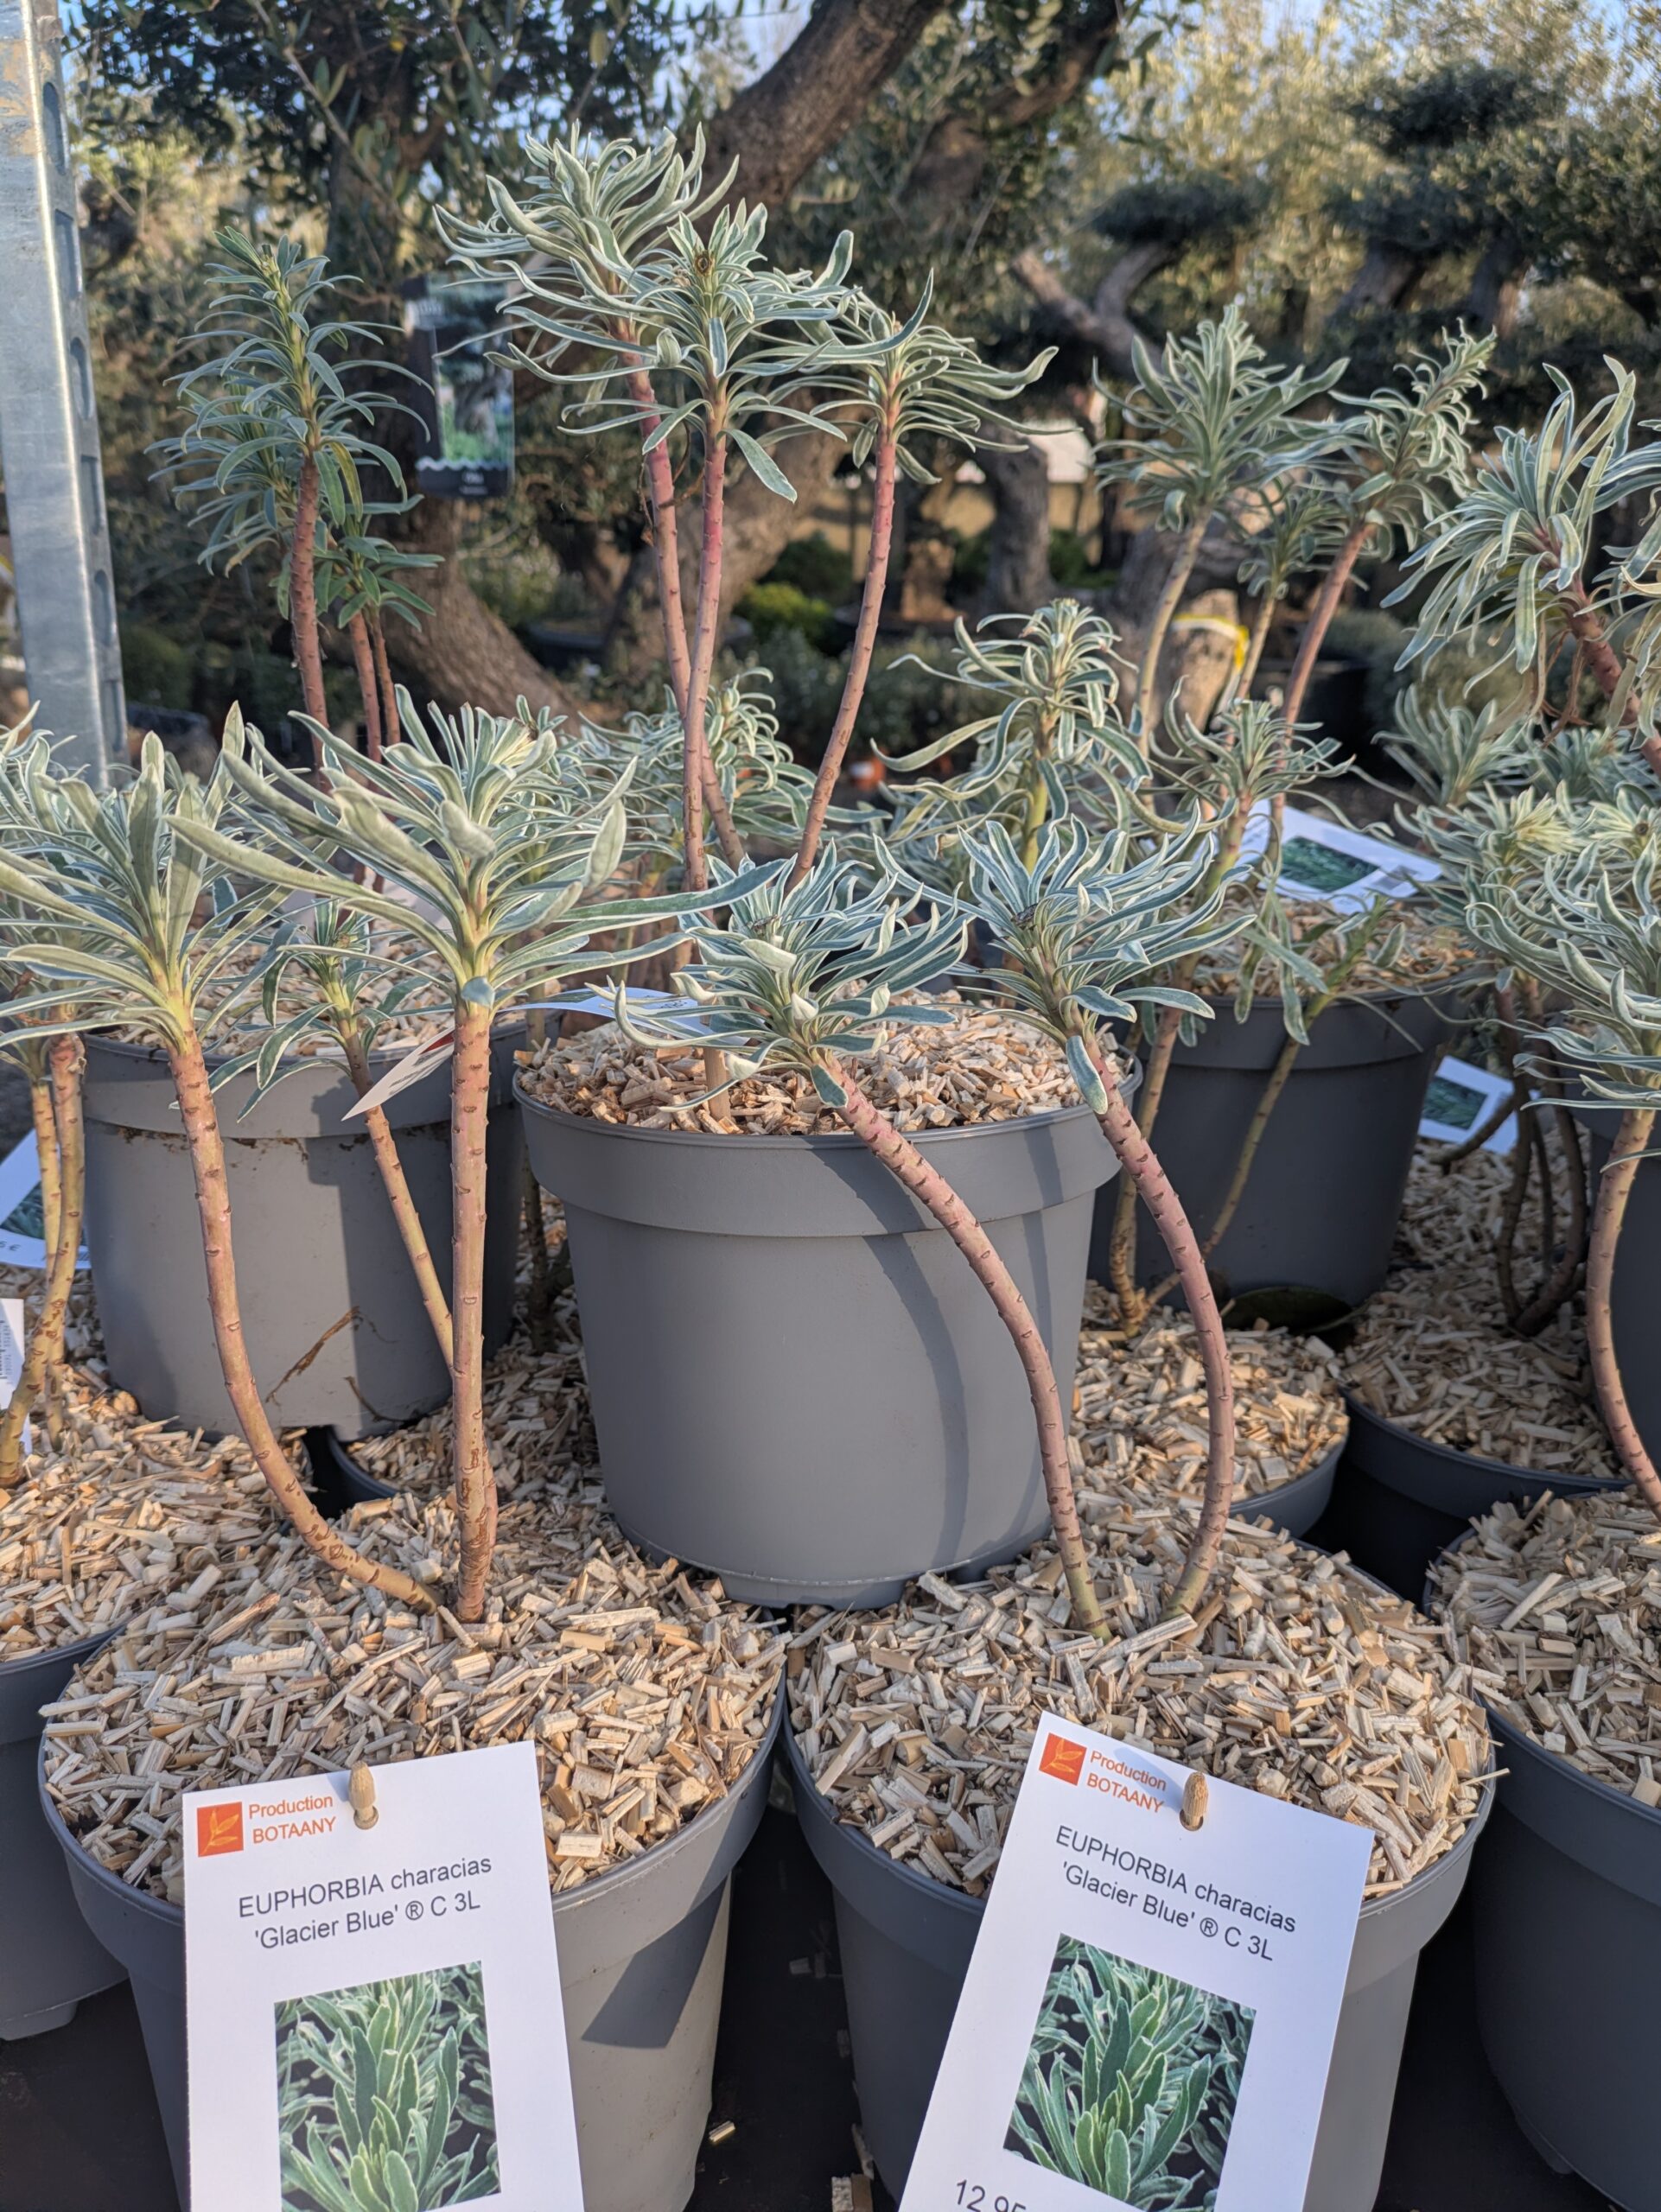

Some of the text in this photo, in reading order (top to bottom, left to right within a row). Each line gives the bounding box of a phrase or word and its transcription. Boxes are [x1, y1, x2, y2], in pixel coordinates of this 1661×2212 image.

[1086, 1773, 1164, 1814] BOTAANY
[1090, 1751, 1167, 1791] Production
[248, 1794, 334, 1819] Production
[252, 1816, 336, 1844] BOTAANY
[239, 1855, 493, 1917] EUPHORBIA characias
[1055, 1825, 1296, 1933] EUPHORBIA characias
[254, 1916, 339, 1949] 'Glacier
[347, 1904, 398, 1933] Blue'
[431, 1895, 448, 1916] C
[455, 1889, 480, 1914] 3L
[1063, 1861, 1138, 1908] 'Glacier
[1142, 1893, 1195, 1928] Blue'
[1225, 1926, 1241, 1948] C
[1247, 1936, 1273, 1961] 3L
